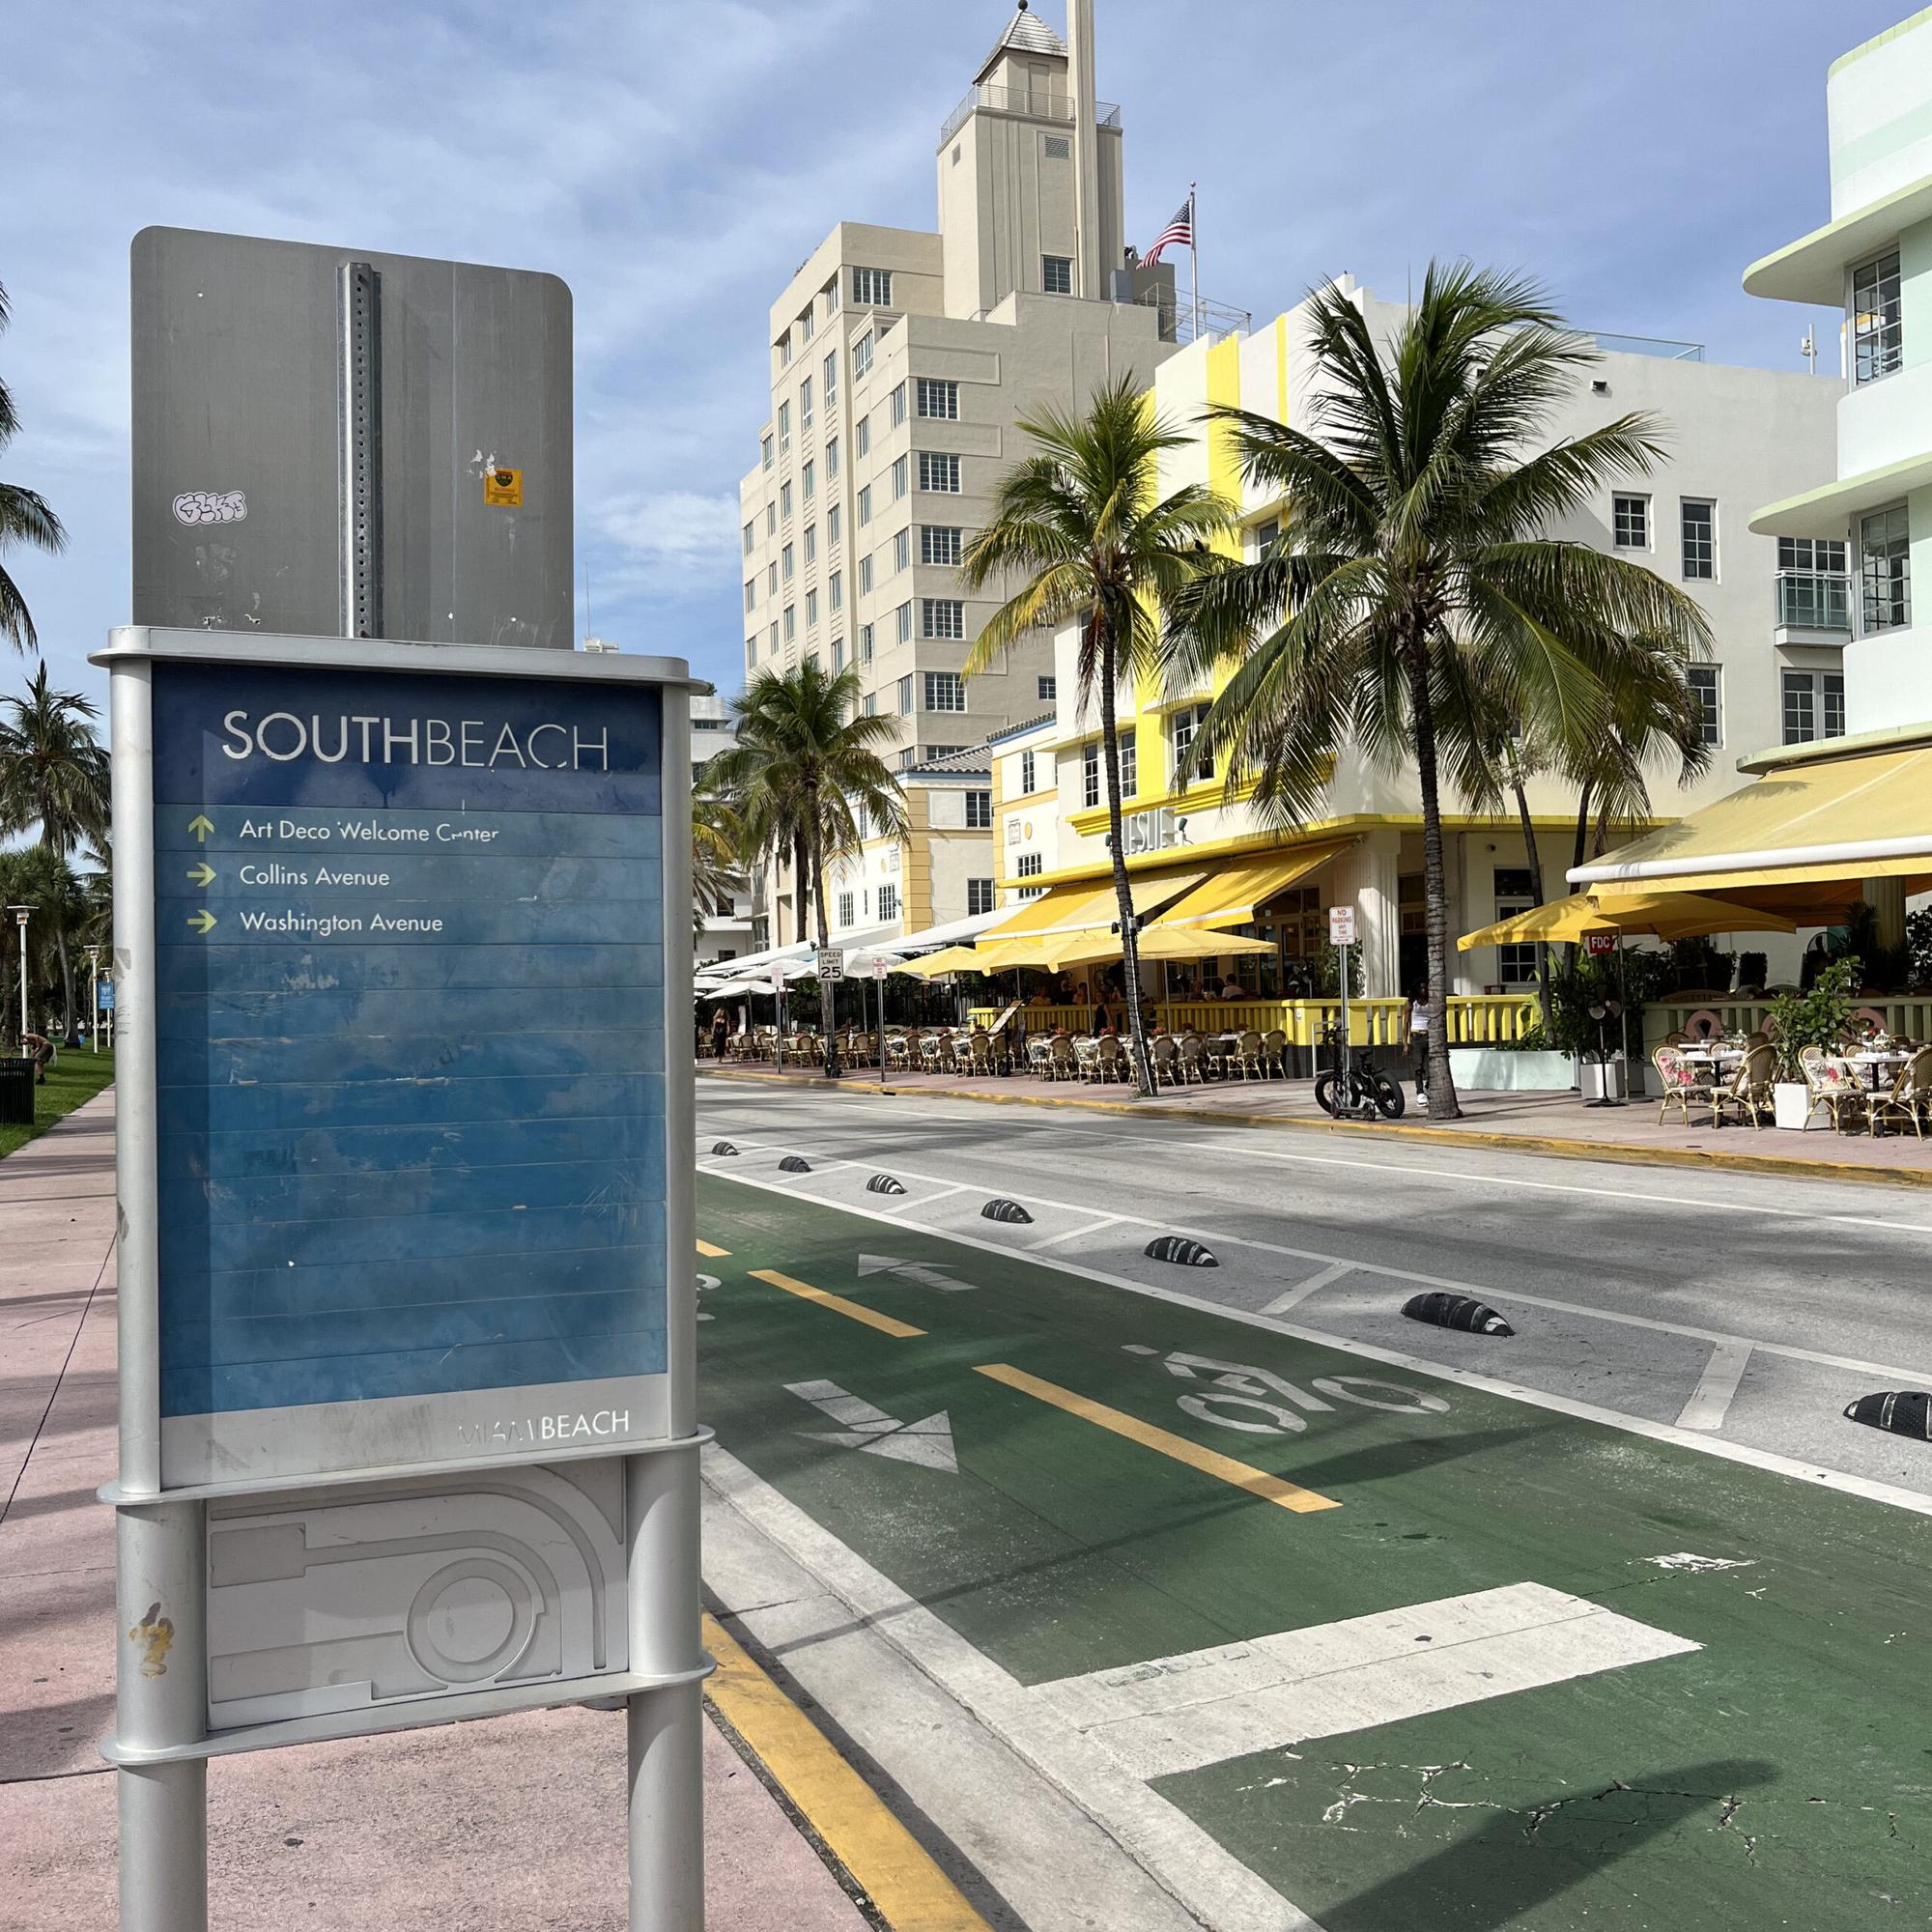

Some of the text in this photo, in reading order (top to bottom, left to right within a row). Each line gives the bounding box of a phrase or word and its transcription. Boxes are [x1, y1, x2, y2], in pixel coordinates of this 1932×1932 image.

[222, 710, 608, 771] SOUTHBEACH
[240, 819, 272, 838] Art
[279, 820, 330, 839] Deco
[337, 819, 430, 841] Welcome
[240, 864, 390, 886] Collins Avenue
[240, 909, 443, 937] Washington Avenue
[1591, 936, 1610, 949] FDC
[821, 966, 841, 979] 25
